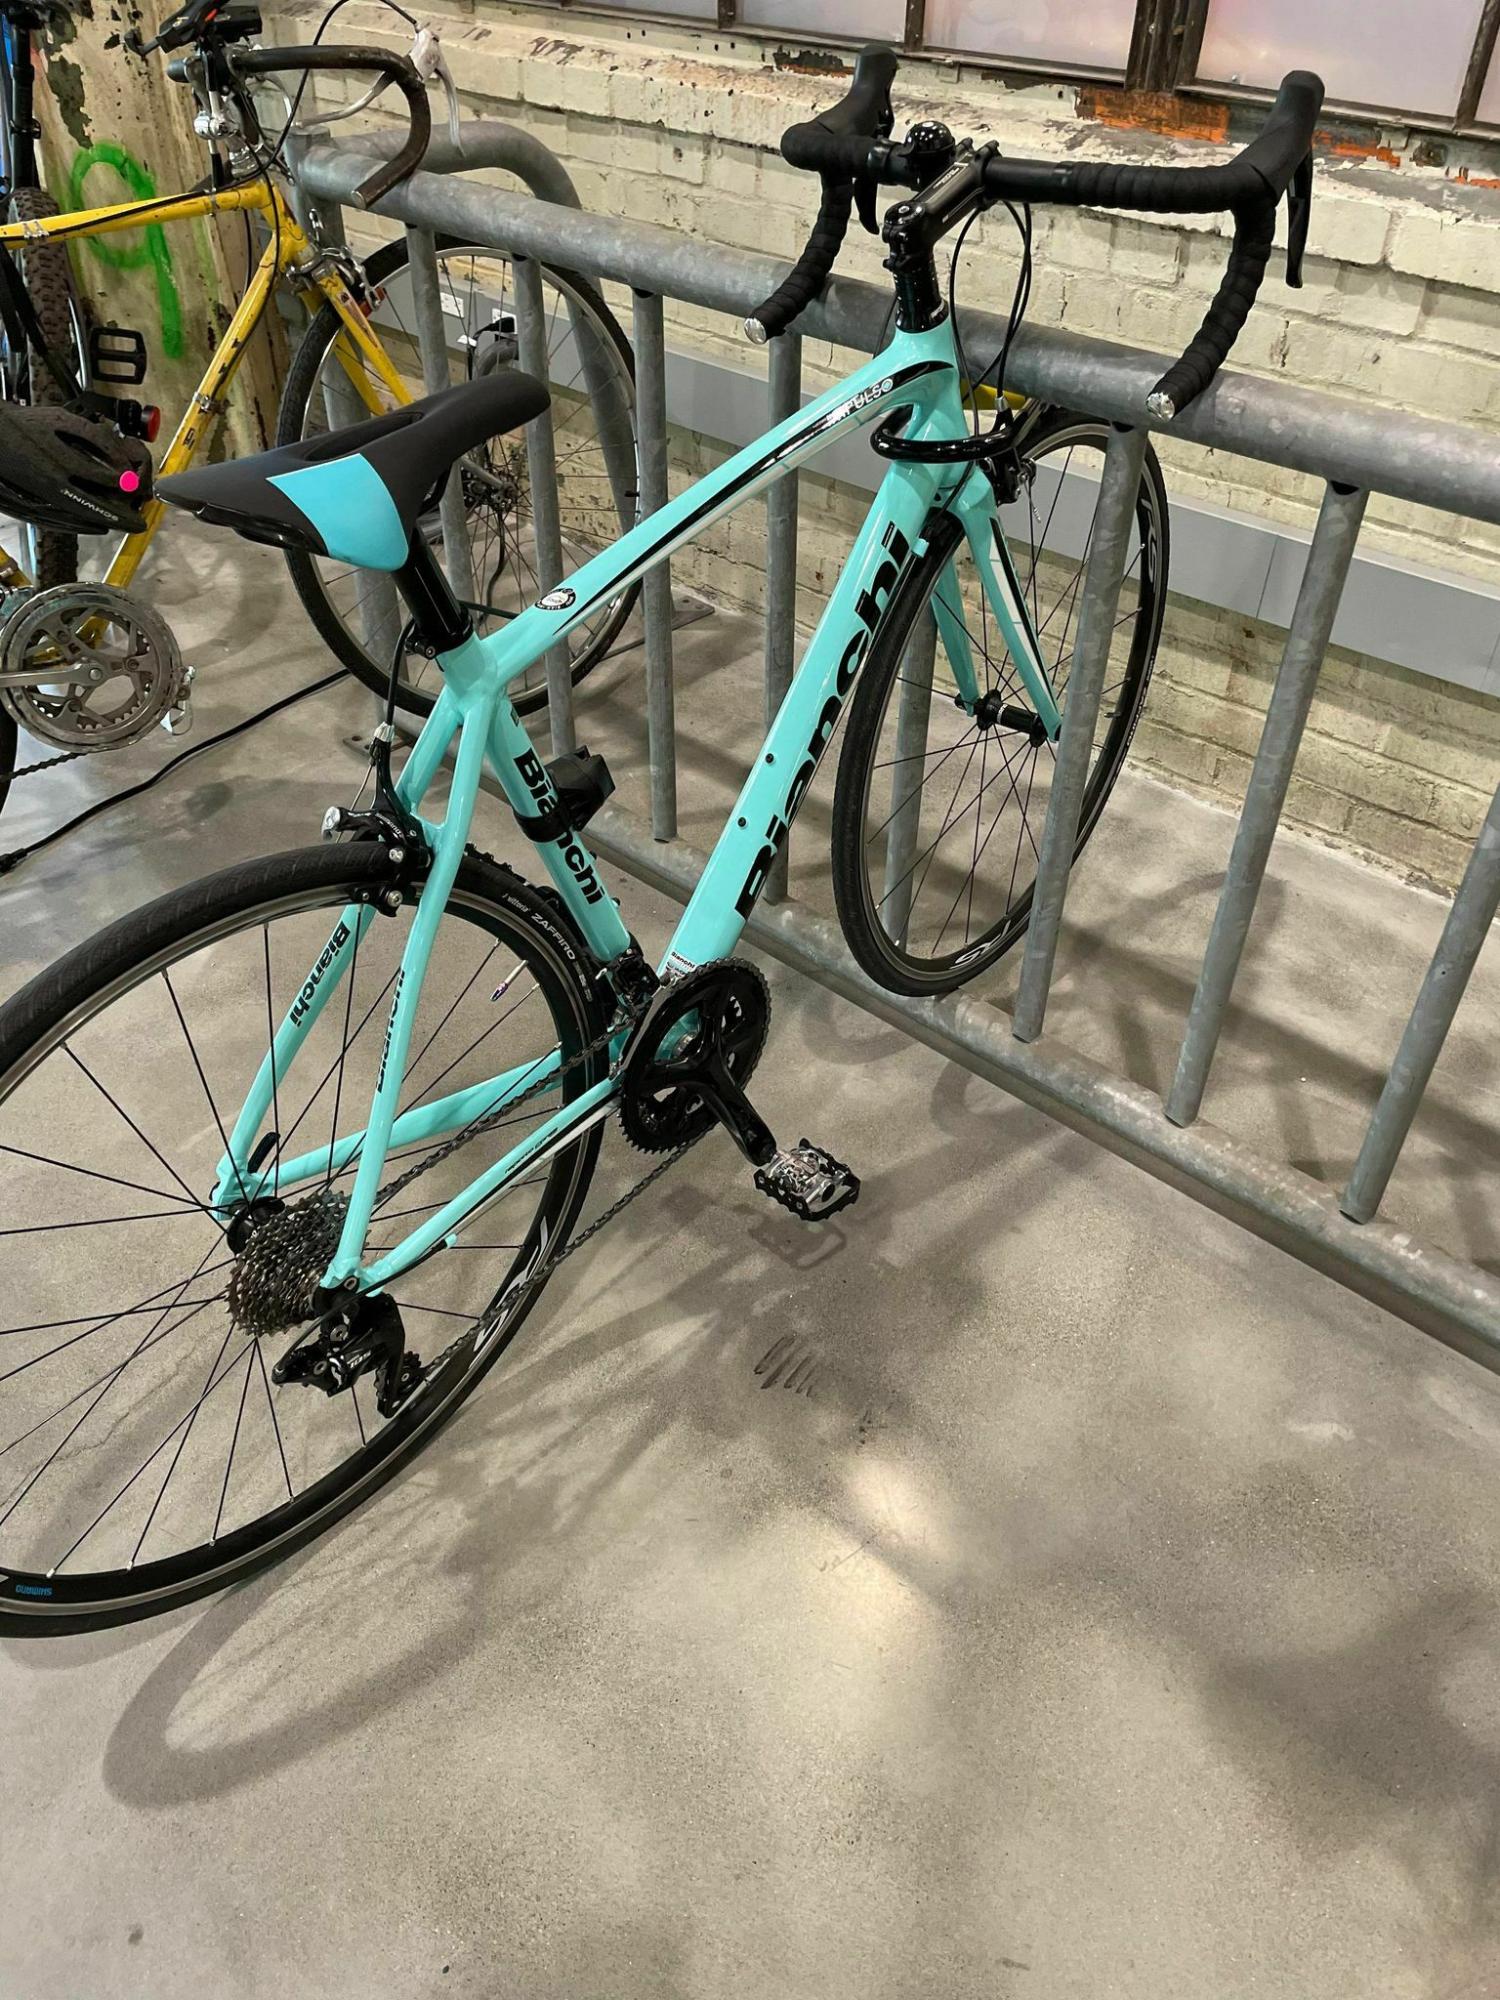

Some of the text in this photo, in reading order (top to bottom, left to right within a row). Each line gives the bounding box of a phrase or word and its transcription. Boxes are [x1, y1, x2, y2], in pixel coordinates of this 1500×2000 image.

[63, 489, 119, 521] SCHWINN
[735, 521, 910, 921] Bianchi
[531, 912, 576, 960] ZAFFIRO
[671, 951, 696, 969] Bianchi
[289, 920, 351, 1028] Bianchi
